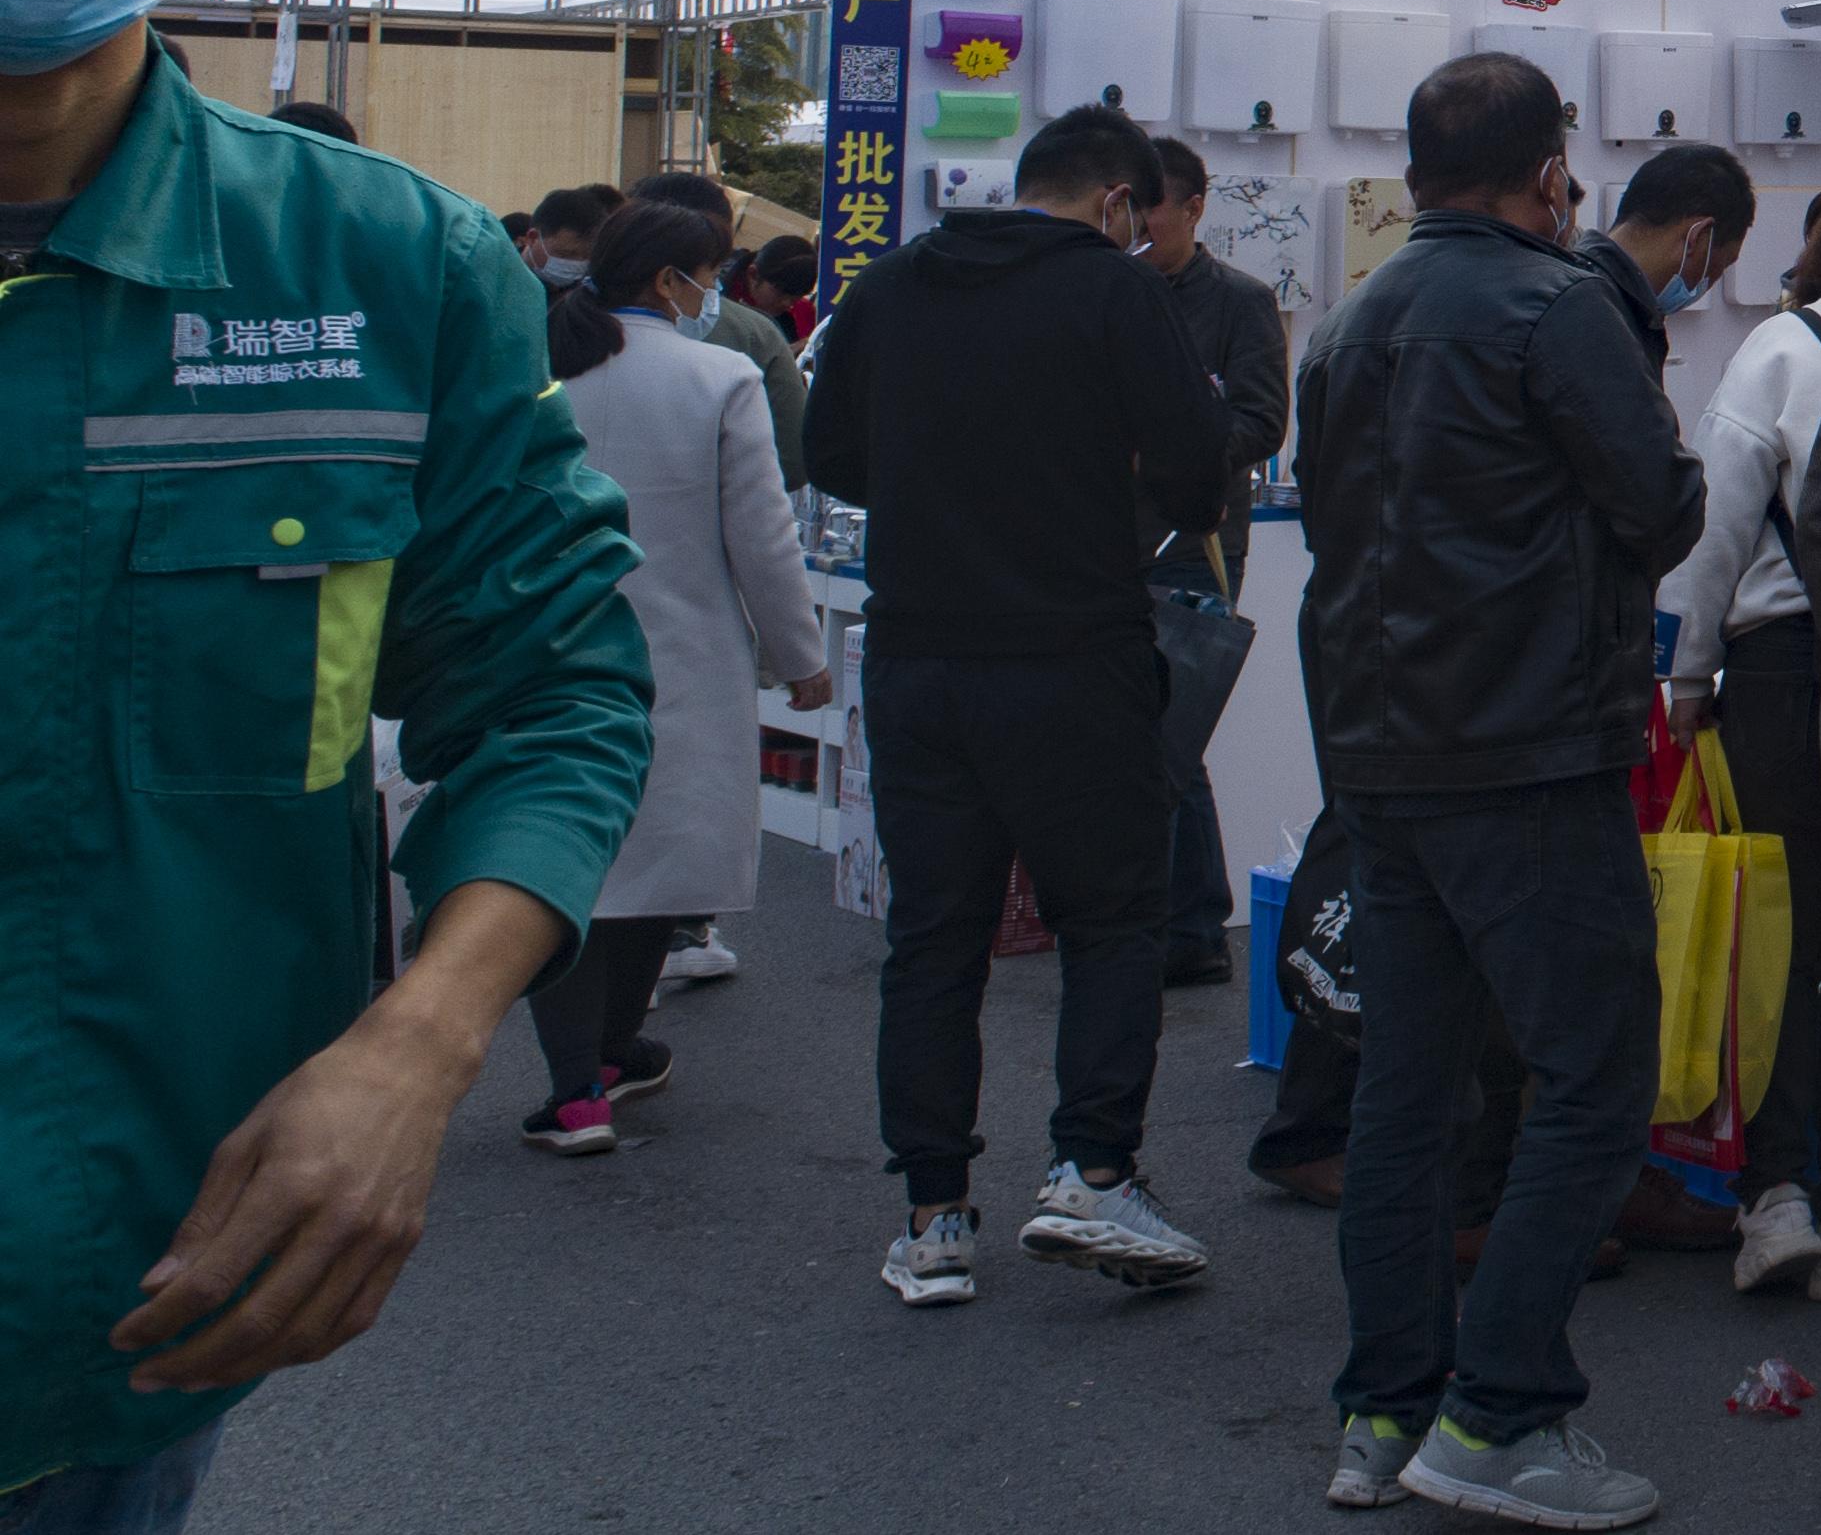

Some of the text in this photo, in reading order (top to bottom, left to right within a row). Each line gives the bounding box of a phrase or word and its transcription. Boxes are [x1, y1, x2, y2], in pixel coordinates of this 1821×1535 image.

[222, 315, 360, 357] 瑞智星
[174, 357, 366, 386] 高端智能晾衣系统
